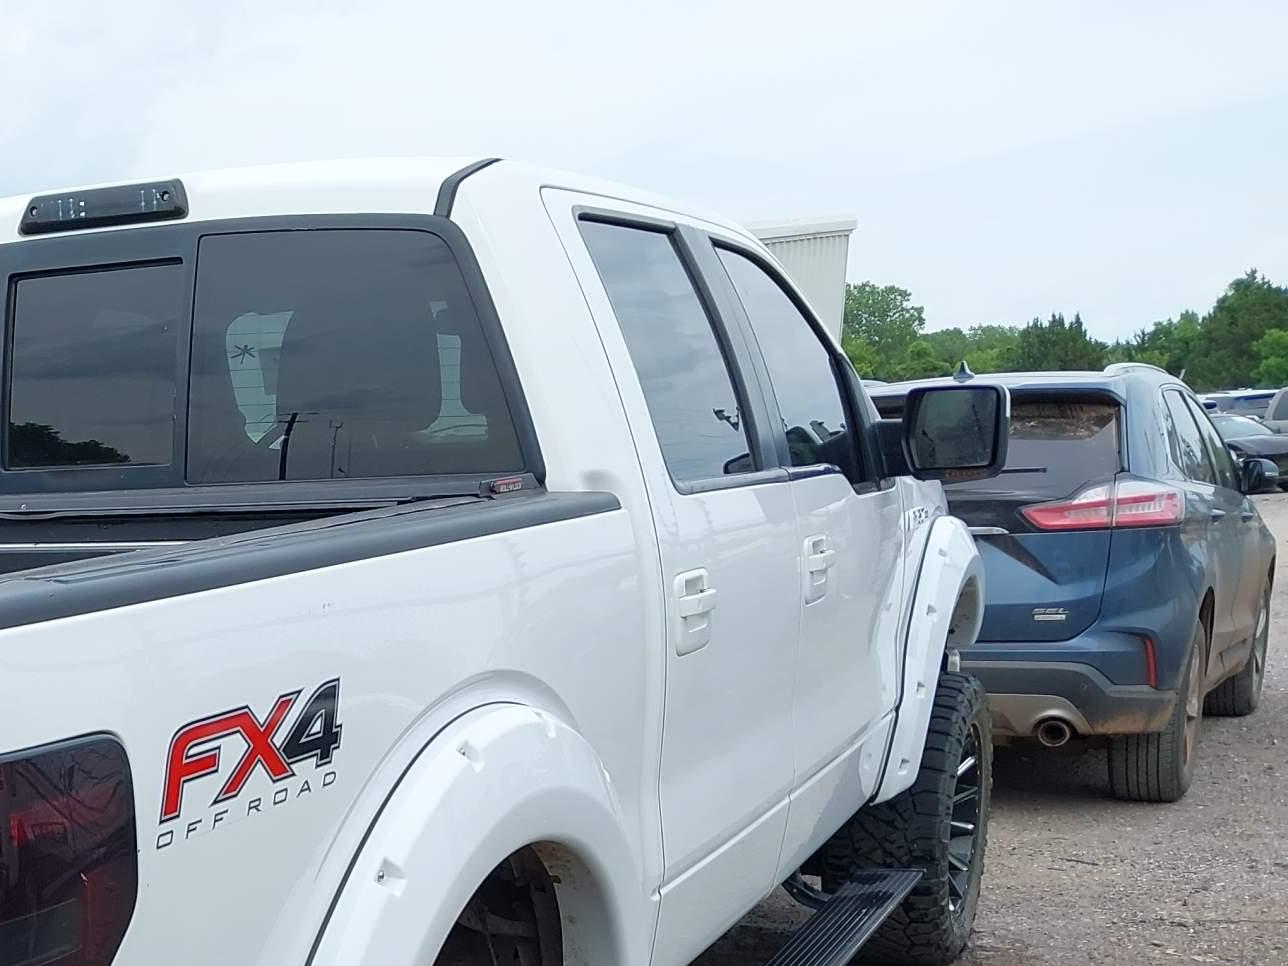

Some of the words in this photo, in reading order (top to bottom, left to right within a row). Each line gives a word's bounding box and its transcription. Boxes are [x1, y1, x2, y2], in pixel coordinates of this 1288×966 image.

[159, 676, 343, 825] FX4
[156, 809, 229, 850] OFF
[247, 771, 337, 816] ROAD
